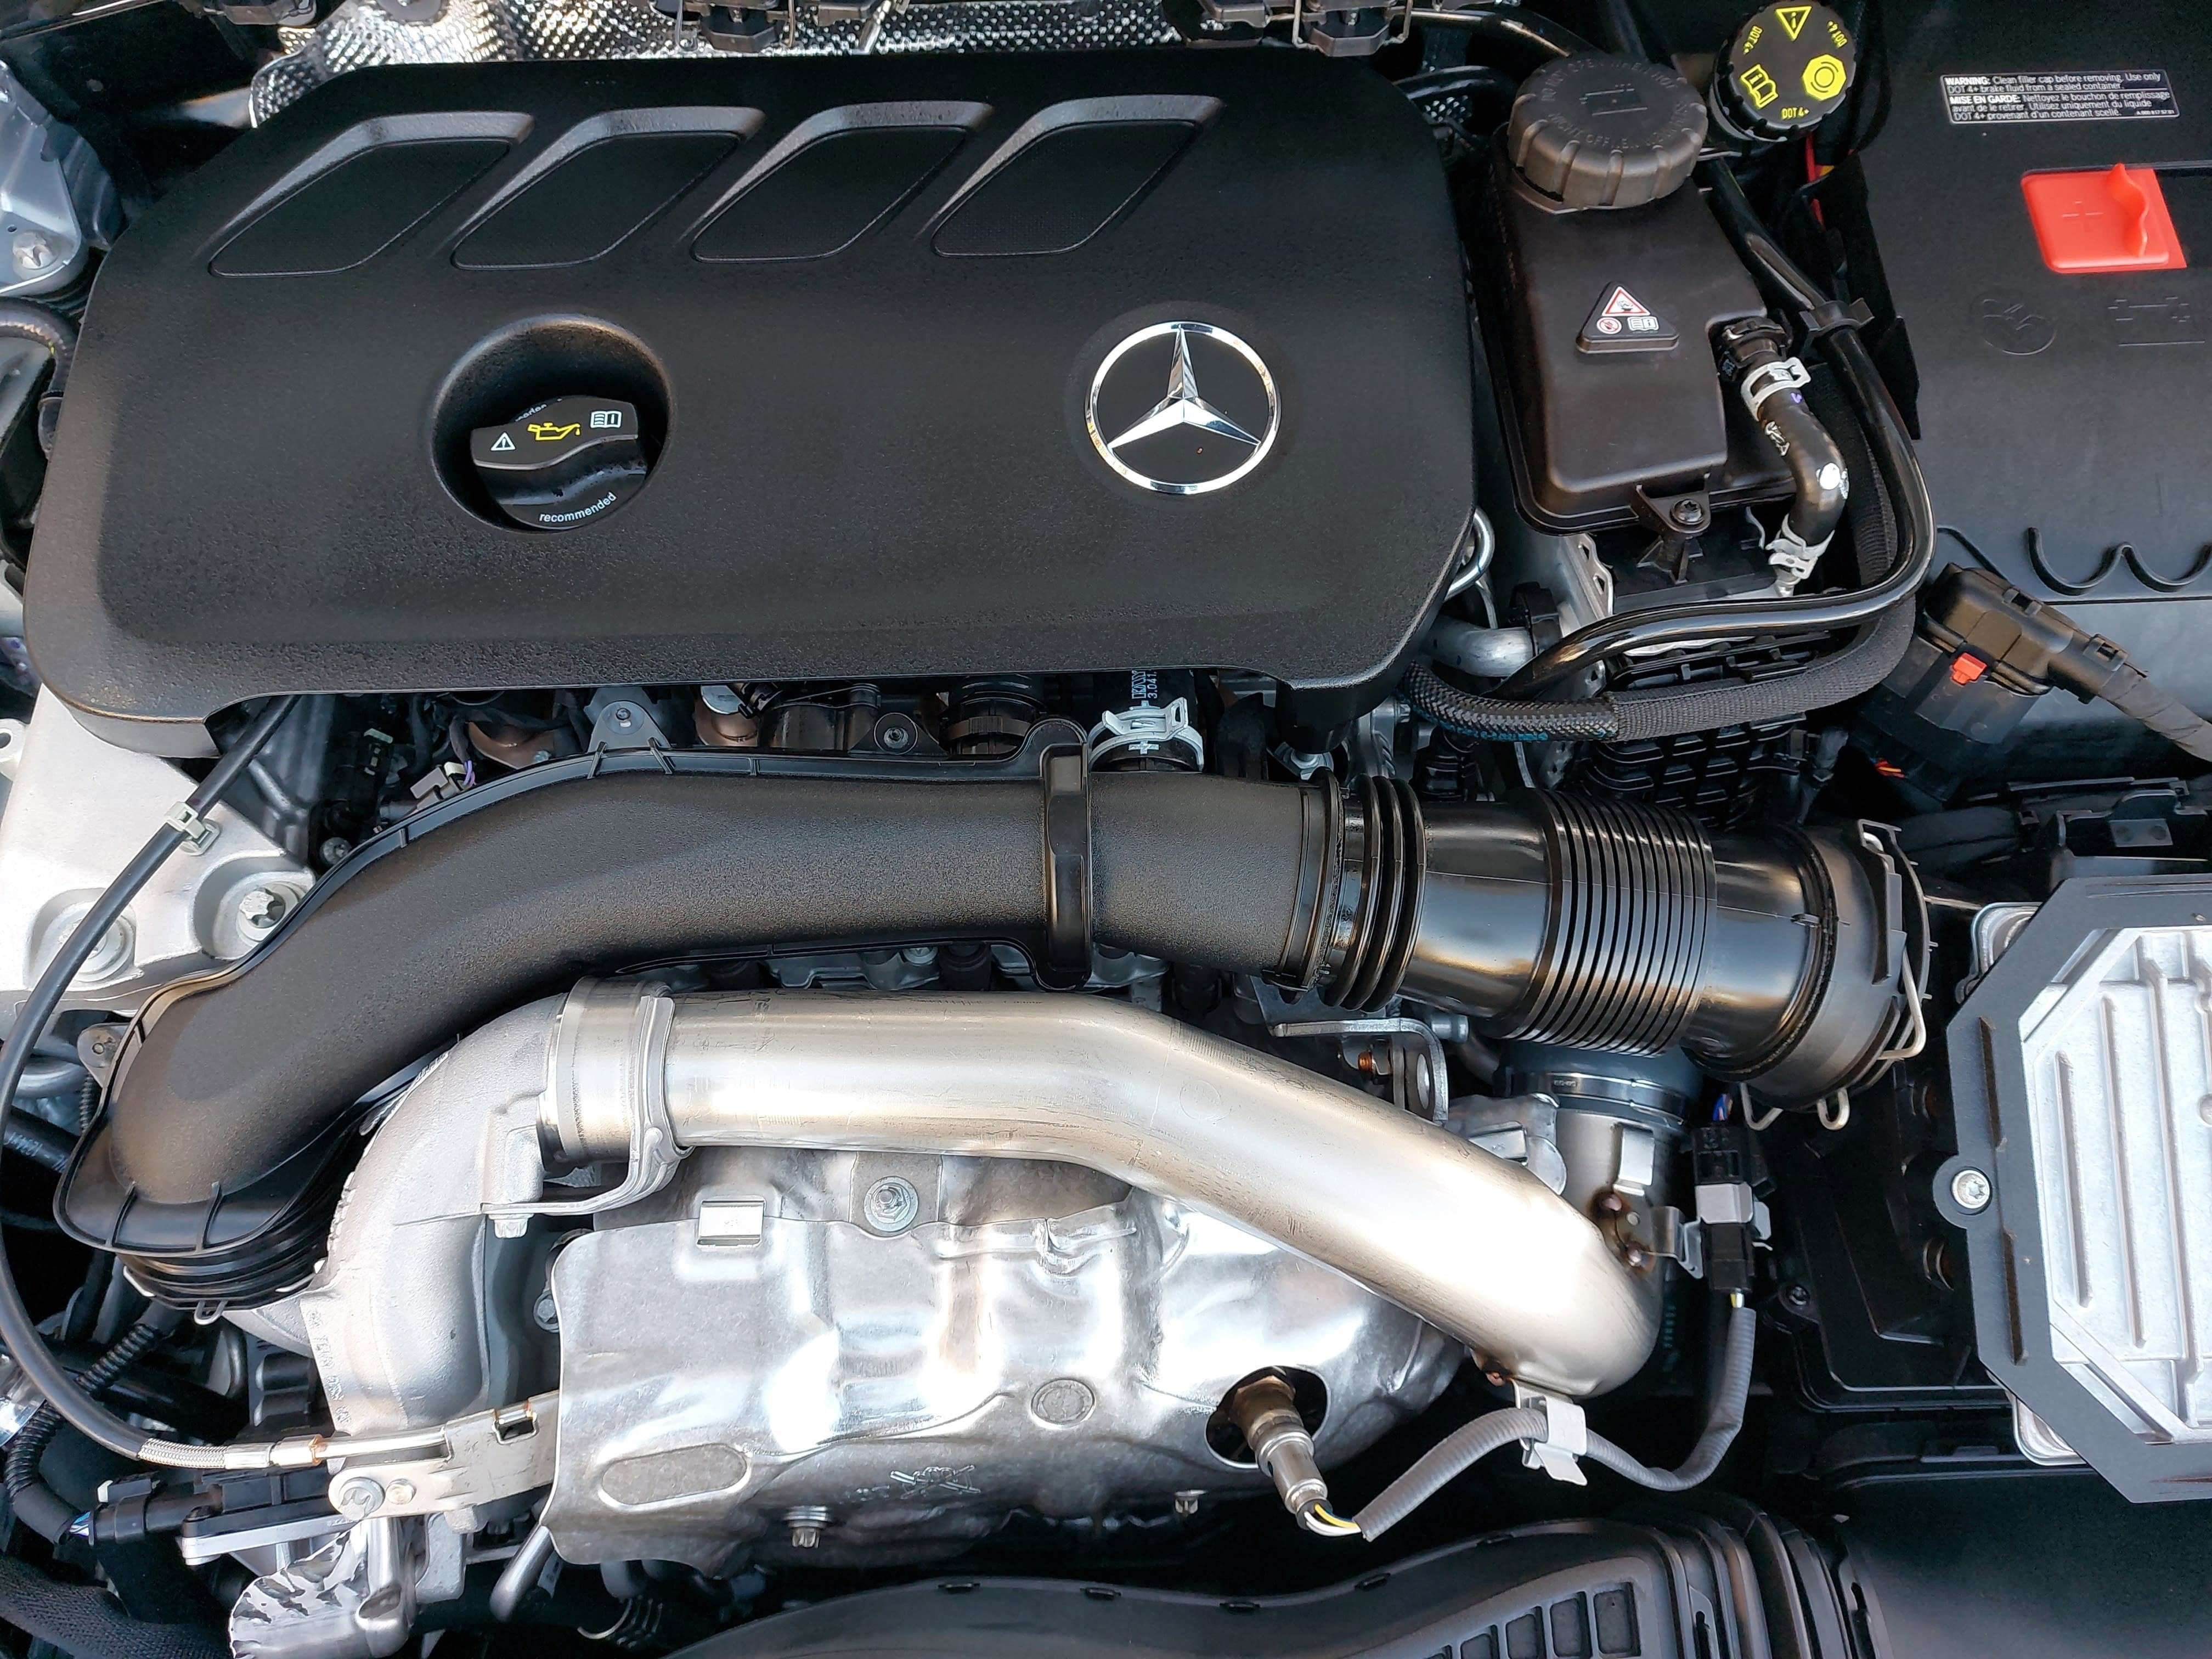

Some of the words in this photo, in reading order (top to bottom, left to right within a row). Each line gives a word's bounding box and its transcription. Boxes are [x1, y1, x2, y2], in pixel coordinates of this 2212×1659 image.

[1750, 25, 1764, 44] DOT
[1832, 30, 1848, 48] DOT
[1944, 76, 1991, 85] WARNING:
[1992, 76, 2017, 84] Clean
[2018, 75, 2036, 84] filler
[2038, 76, 2055, 84] cap
[2055, 74, 2082, 83] before
[2083, 73, 2124, 83] removing.
[2125, 72, 2142, 81] Use
[2143, 72, 2161, 82] only
[1947, 85, 1966, 93] DOT
[1980, 84, 2004, 93] brake
[2005, 84, 2024, 92] fluid
[2025, 83, 2046, 92] from
[2055, 82, 2081, 90] sealed
[2083, 81, 2125, 90] container.
[1950, 95, 1973, 104] MISE
[1973, 95, 1987, 104] EN
[1987, 94, 2021, 103] GARDE:
[2022, 93, 2060, 103] Nettoyez
[2061, 93, 2069, 101] le
[2071, 92, 2107, 101] bouchon
[2108, 92, 2119, 100] de
[2119, 90, 2171, 100] remplissage
[1953, 104, 1975, 112] avant
[1989, 103, 1997, 111] le
[2028, 102, 2061, 111] Utilisez
[2062, 100, 2110, 110] uniquement
[2111, 100, 2123, 108] du
[2124, 99, 2153, 109] liquide
[1781, 108, 1798, 120] DOT
[1797, 107, 1810, 117] 4+
[1955, 112, 1972, 121] DOT
[1987, 111, 2029, 120] provenant
[2030, 110, 2050, 119] d'un
[2050, 109, 2093, 119] contenant
[539, 492, 617, 523] recommended
